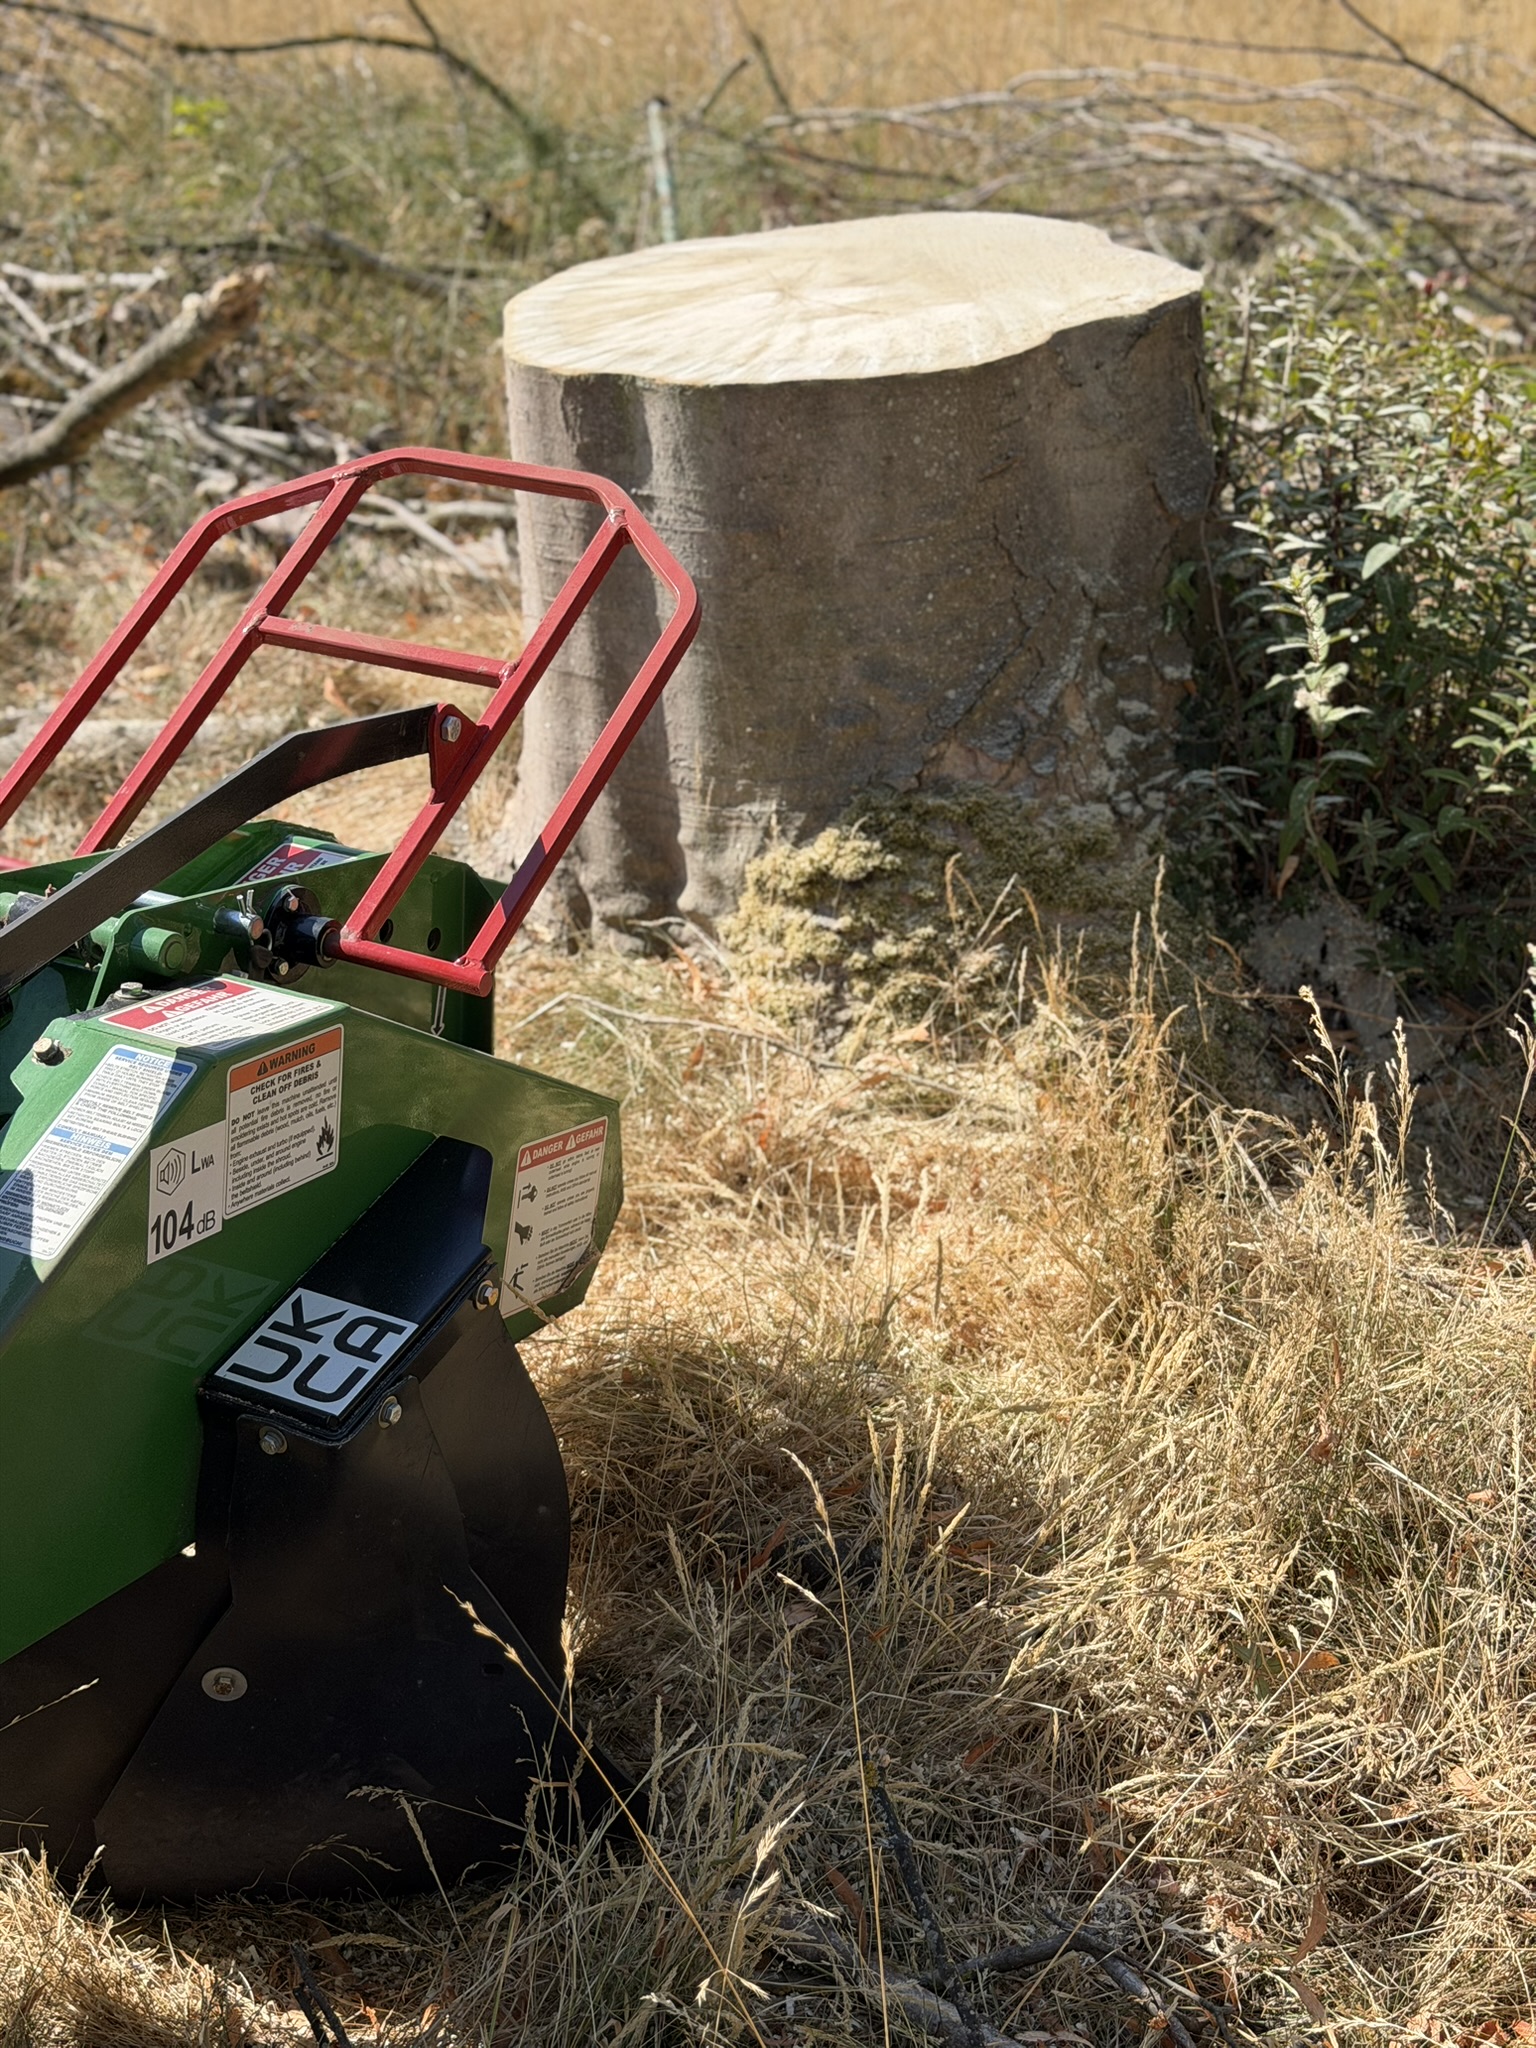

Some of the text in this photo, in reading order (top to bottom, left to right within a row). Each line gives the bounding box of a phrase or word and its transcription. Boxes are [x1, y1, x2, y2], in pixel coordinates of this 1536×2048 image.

[154, 986, 216, 1006] DANGER
[173, 991, 233, 1011] GEFAHR
[134, 1054, 172, 1067] NOTICE
[269, 1043, 315, 1069] WARNING
[250, 1078, 275, 1094] CHECK
[277, 1071, 291, 1083] FOR
[293, 1062, 313, 1076] FIRES
[252, 1071, 318, 1104] CLEAN OFF DEBRIS
[242, 1110, 254, 1121] NOT
[281, 1092, 300, 1104] machine
[302, 1081, 326, 1095] unattended
[238, 1117, 258, 1132] potential
[69, 1133, 111, 1148] HINWEIS
[275, 1144, 290, 1155] around
[533, 1126, 603, 1158] DANGER GEFAHR
[232, 1155, 248, 1166] Engine
[249, 1147, 266, 1159] exhaust
[231, 1170, 252, 1183] including
[256, 1168, 271, 1180] around
[231, 1194, 253, 1207] Anywhere
[254, 1184, 274, 1196] materials
[151, 1200, 216, 1254] 104 dB
[226, 1293, 350, 1383] UK
[293, 1315, 408, 1403] CA
